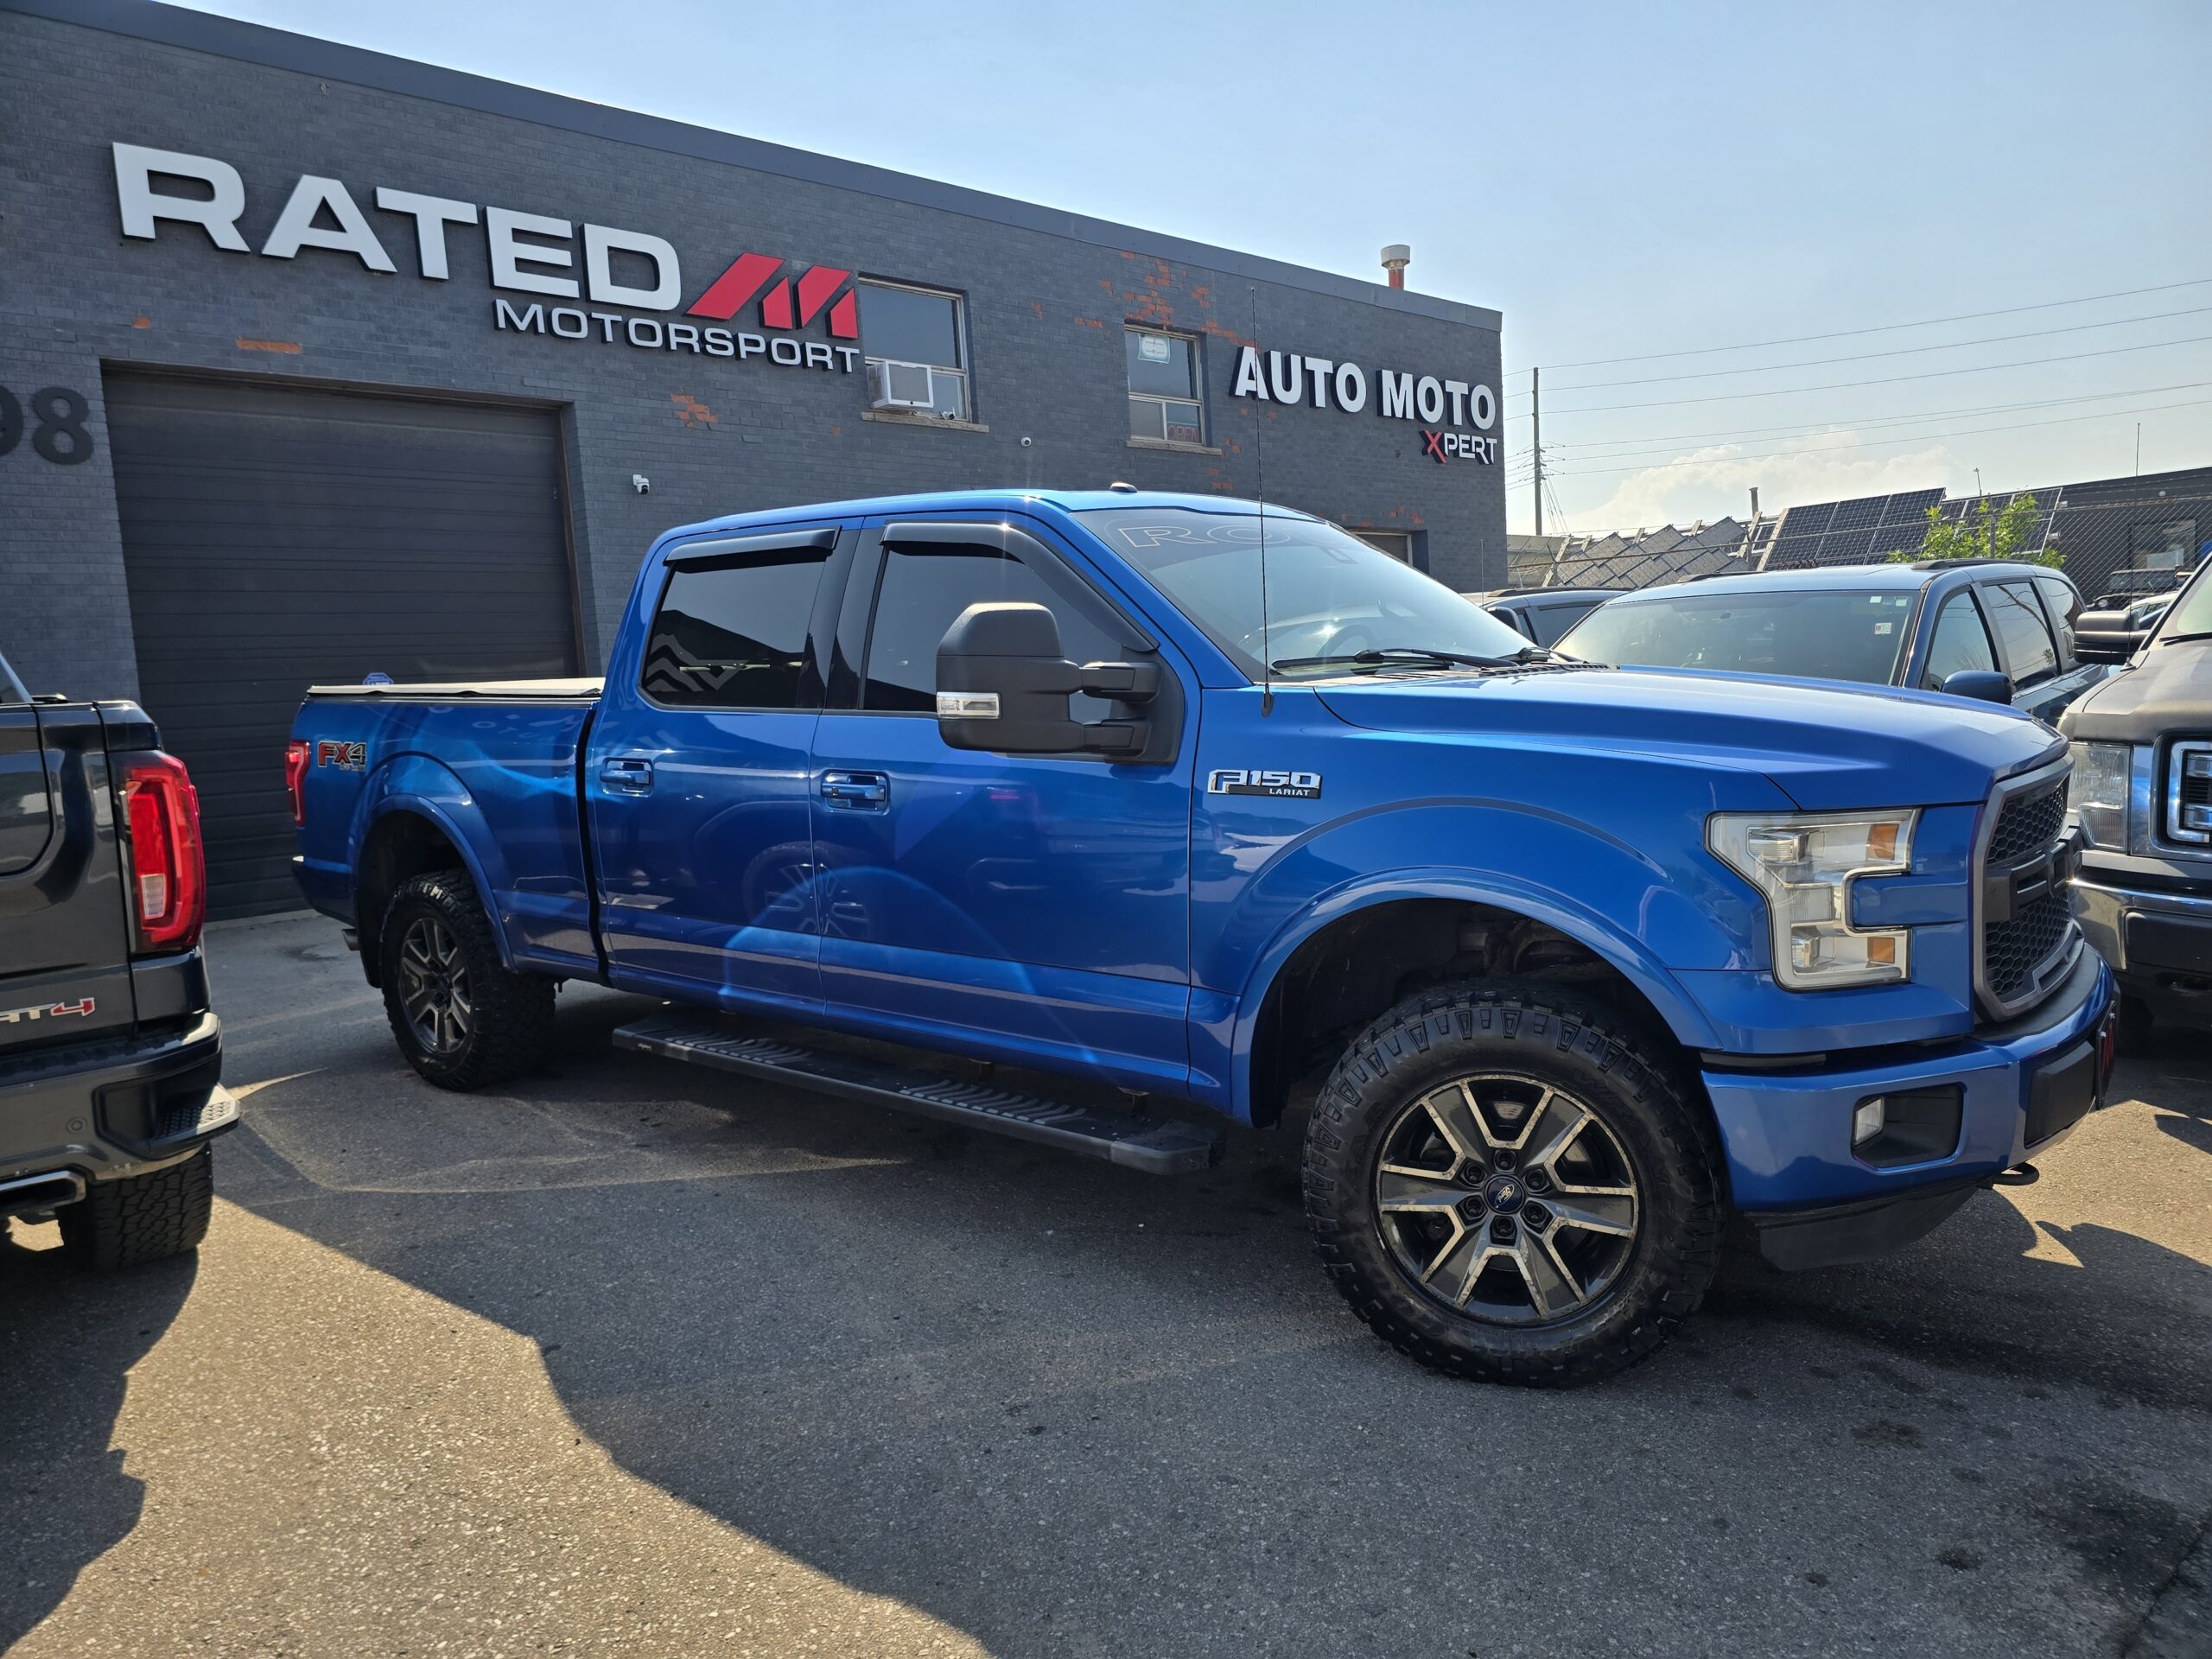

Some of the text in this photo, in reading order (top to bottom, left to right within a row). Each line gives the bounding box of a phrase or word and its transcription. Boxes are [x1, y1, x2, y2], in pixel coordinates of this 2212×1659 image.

[113, 142, 681, 310] RATED
[495, 299, 860, 372] MOTORSPORT
[1234, 346, 1497, 430] AUTO MOTO
[1167, 424, 1199, 442] OPEN
[1424, 429, 1497, 464] XPERT
[317, 741, 366, 768] FX4
[1268, 788, 1310, 797] LARIAT
